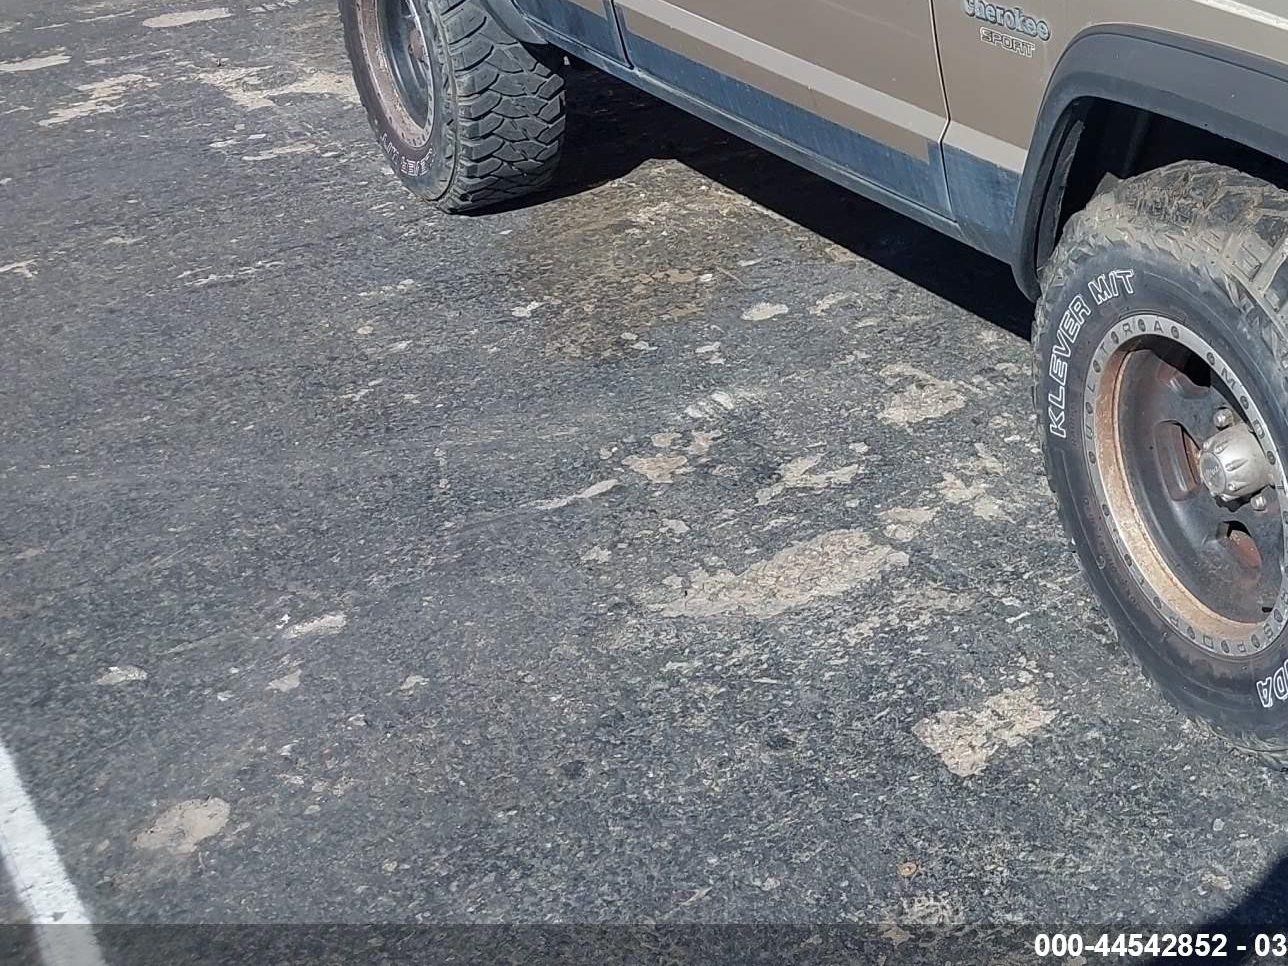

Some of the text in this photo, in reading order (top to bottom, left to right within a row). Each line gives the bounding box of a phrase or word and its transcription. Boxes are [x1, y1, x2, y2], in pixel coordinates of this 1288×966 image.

[980, 26, 1036, 58] SPORT
[1048, 268, 1135, 439] KLEVER M/T
